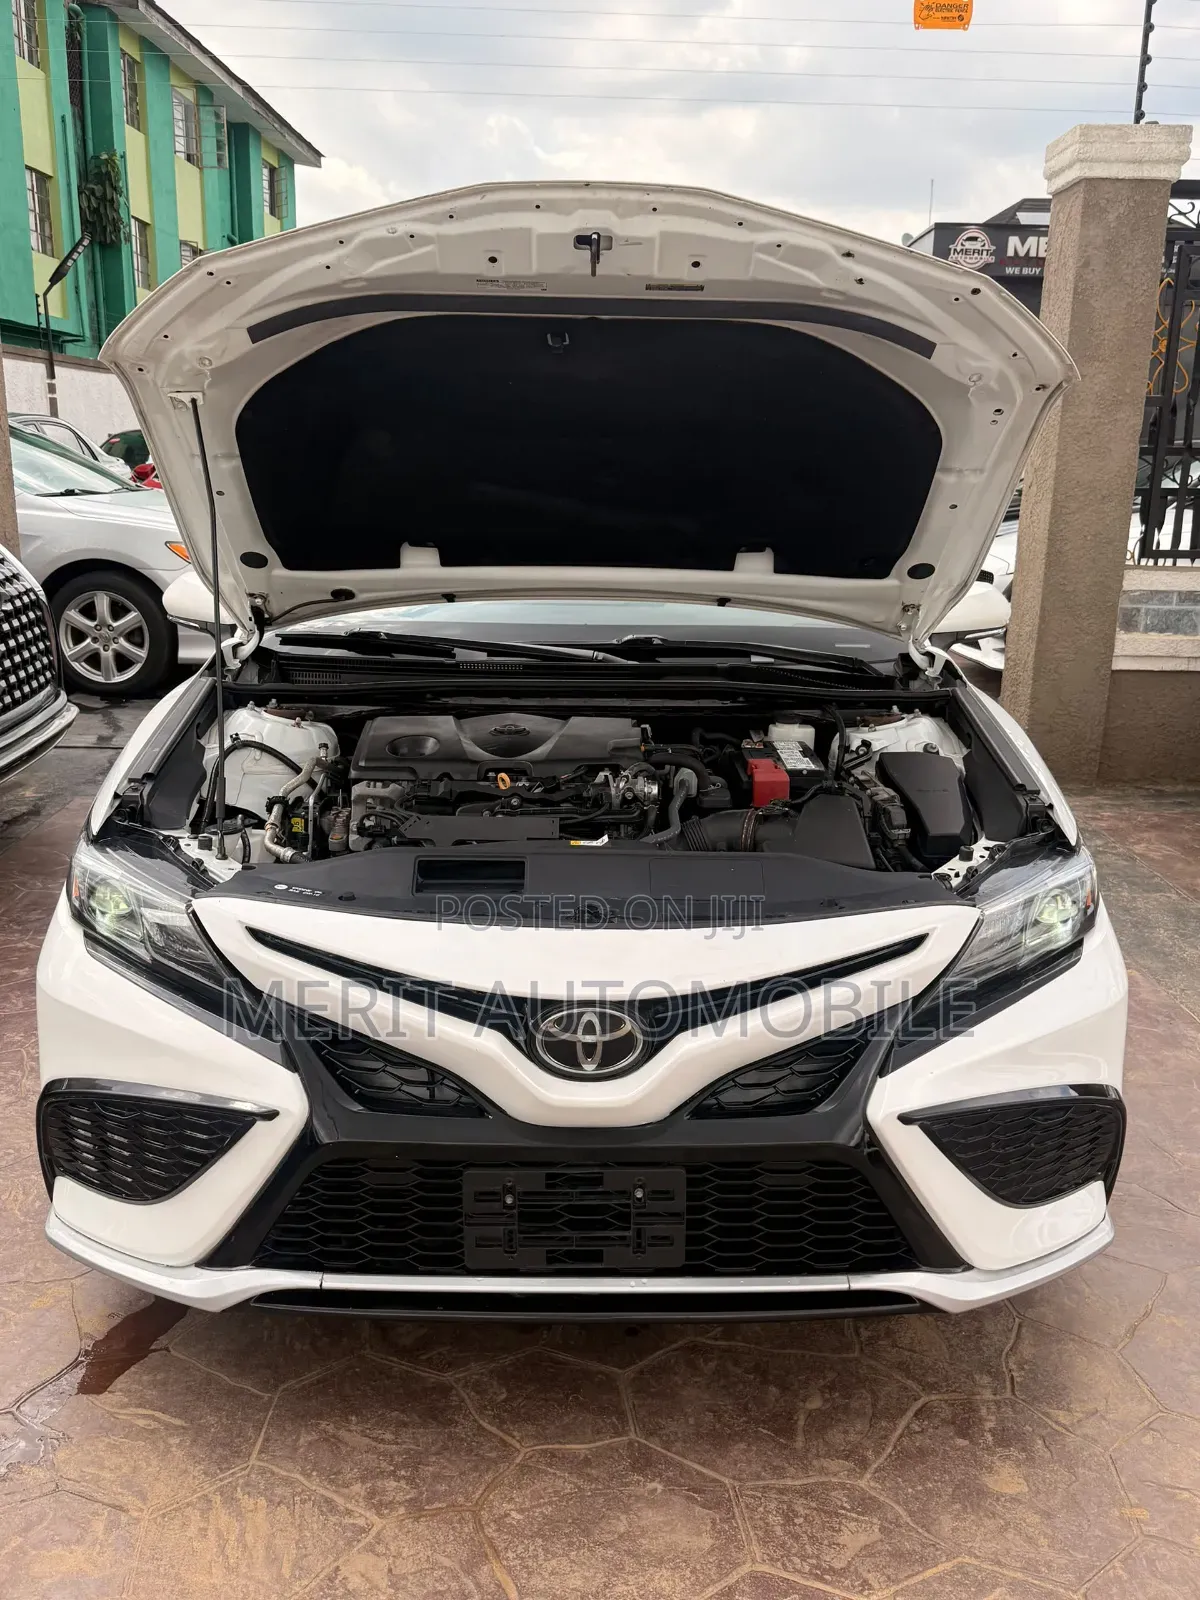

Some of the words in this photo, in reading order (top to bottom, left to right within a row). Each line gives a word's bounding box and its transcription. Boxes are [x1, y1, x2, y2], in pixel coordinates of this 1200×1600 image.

[952, 247, 992, 256] MERIT
[1005, 266, 1021, 275] WE
[1021, 266, 1042, 275] BUY
